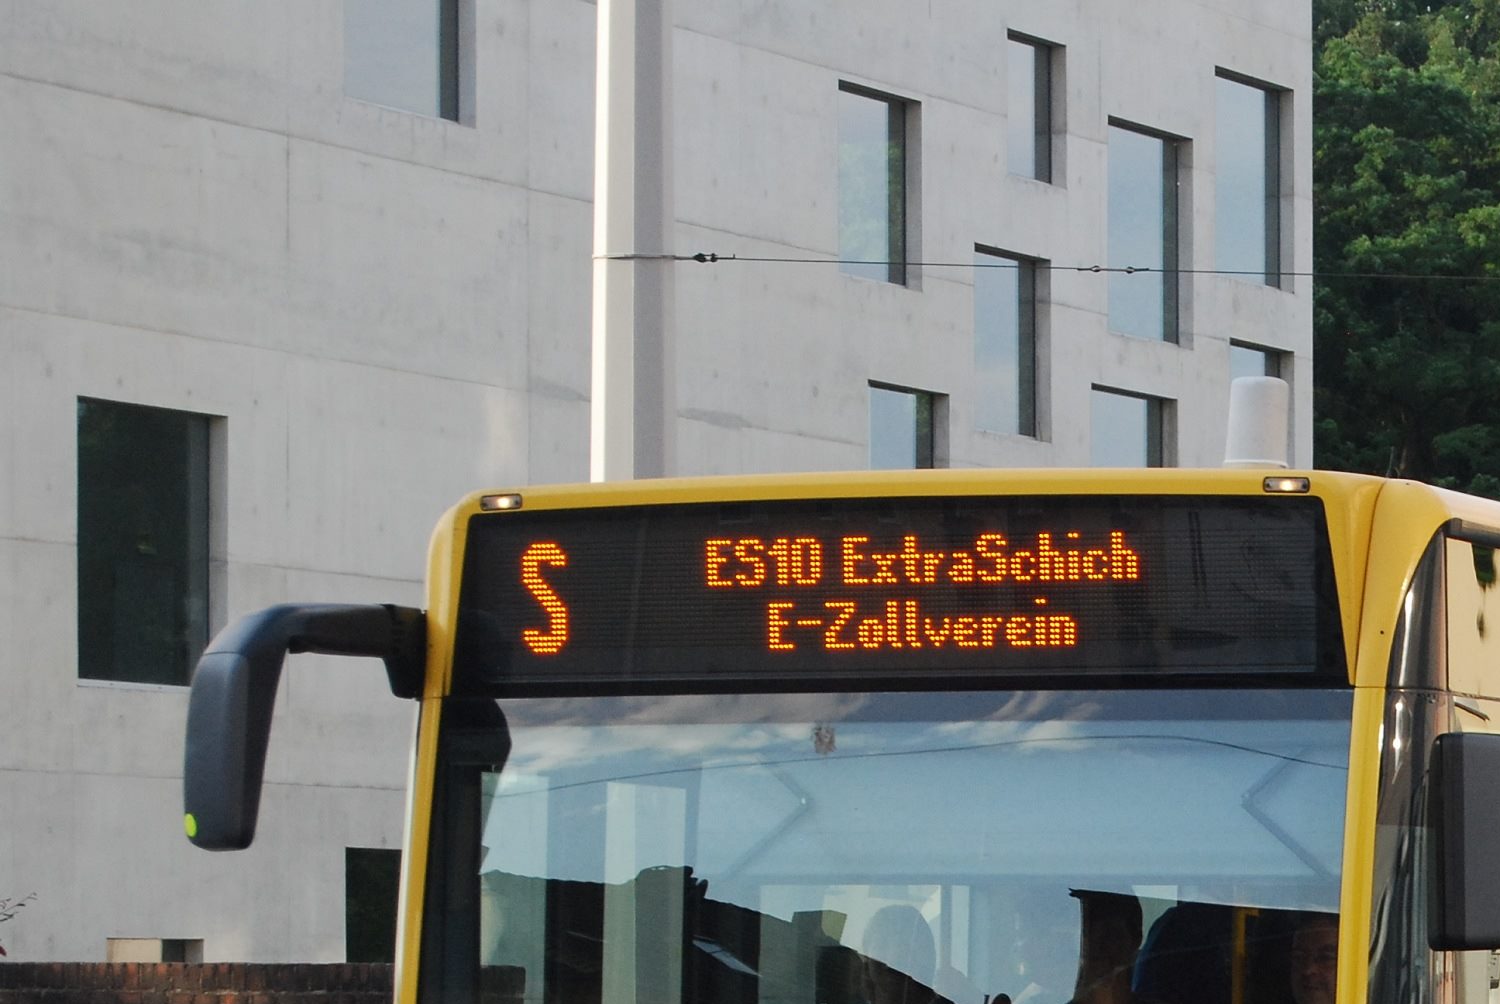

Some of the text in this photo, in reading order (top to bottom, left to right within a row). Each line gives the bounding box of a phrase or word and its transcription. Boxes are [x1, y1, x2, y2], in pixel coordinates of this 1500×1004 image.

[705, 531, 1139, 587] ES10 ExtraSchich
[521, 542, 569, 654] S
[768, 598, 1076, 651] E-Zollverein
